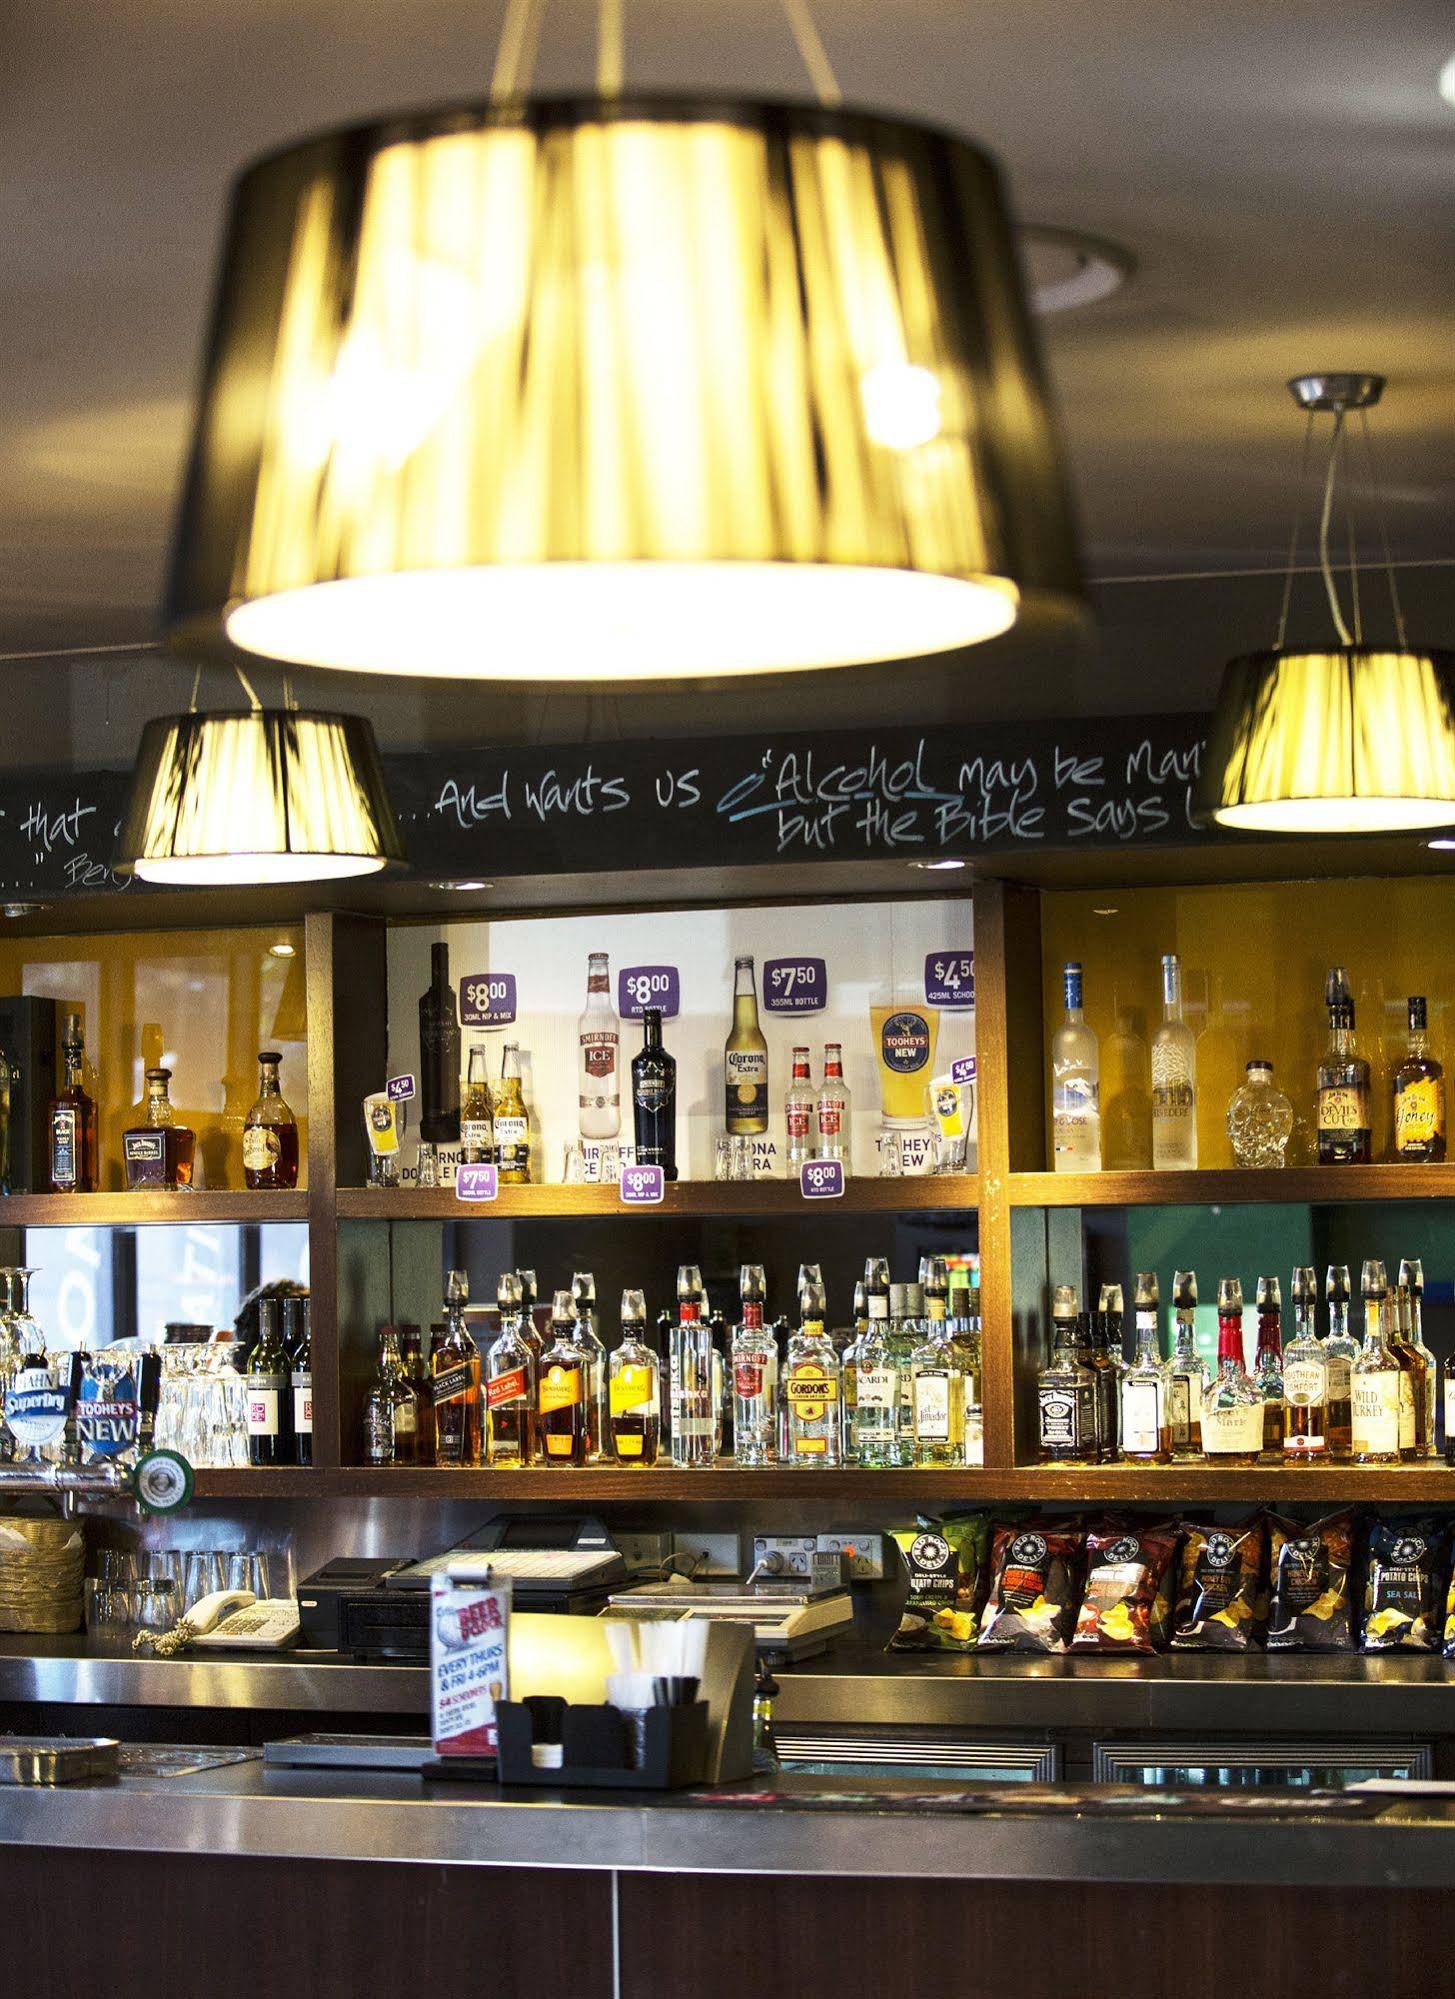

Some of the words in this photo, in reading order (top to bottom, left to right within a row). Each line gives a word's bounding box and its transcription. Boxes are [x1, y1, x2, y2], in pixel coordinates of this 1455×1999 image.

[1055, 745, 1105, 789] be
[20, 797, 97, 852] that
[776, 802, 850, 853] but
[856, 798, 925, 848] the
[935, 788, 1045, 845] Bible
[771, 966, 816, 997] $750
[627, 974, 669, 1004] $800
[953, 990, 975, 999] SCHOO
[466, 981, 507, 1012] $800
[771, 998, 793, 1006] 355ML
[795, 997, 819, 1006] BOTTLE
[886, 1037, 926, 1047] TOOHEYS
[588, 1050, 611, 1061] ICE
[728, 1051, 766, 1066] Corona
[894, 1047, 917, 1058] NEW
[737, 1064, 759, 1073] Extra
[902, 1154, 924, 1167] EW
[807, 1166, 836, 1187] $800
[19, 1373, 55, 1391] AHN
[858, 1375, 889, 1384] CARDI
[1354, 1389, 1378, 1404] WILD
[80, 1402, 134, 1415] TOOHEYS
[76, 1419, 135, 1442] NEW
[914, 1538, 926, 1556] RED
[928, 1535, 947, 1556] ROCK
[1014, 1536, 1028, 1551] RED
[1030, 1534, 1044, 1553] ROCK
[1218, 1535, 1234, 1552] ROC
[920, 1558, 942, 1568] DELI
[1018, 1553, 1037, 1562] DELI
[1108, 1552, 1128, 1561] DELI
[1211, 1556, 1228, 1565] DELI
[911, 1578, 932, 1588] OTATO
[1380, 1571, 1406, 1582] POTATO
[1387, 1590, 1401, 1599] SEA
[1403, 1590, 1420, 1599] SAL
